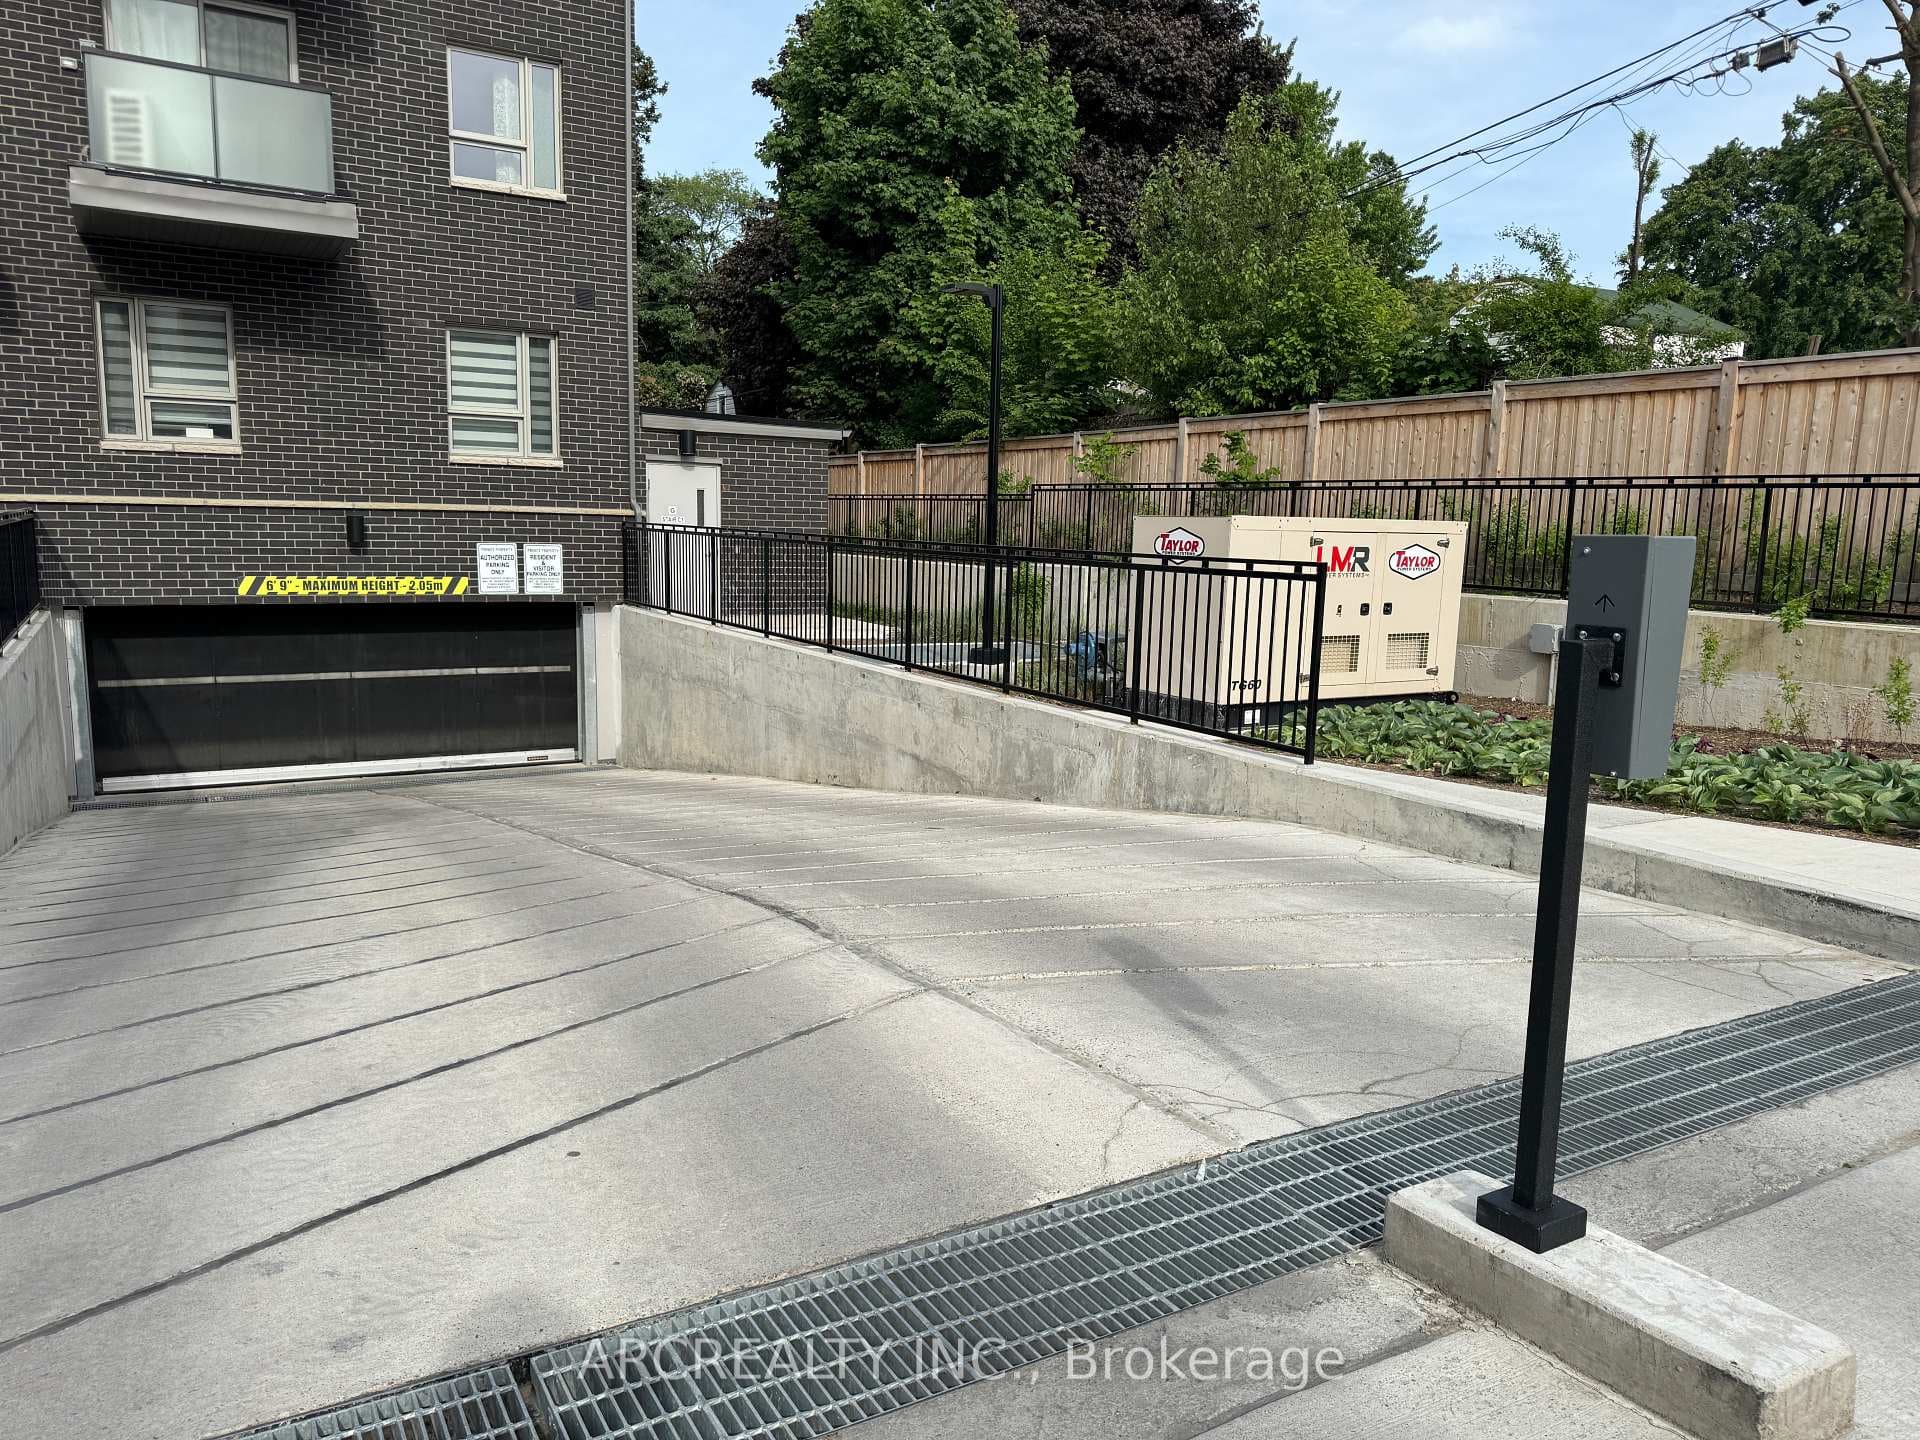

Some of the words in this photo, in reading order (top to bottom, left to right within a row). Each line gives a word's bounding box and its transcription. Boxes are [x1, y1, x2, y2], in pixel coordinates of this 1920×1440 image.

[1160, 533, 1199, 553] TAYLOR
[1395, 551, 1434, 568] TAYLOR
[302, 580, 358, 591] MAXIMUM
[361, 580, 400, 591] HEIGHT
[408, 580, 443, 591] 2.05m
